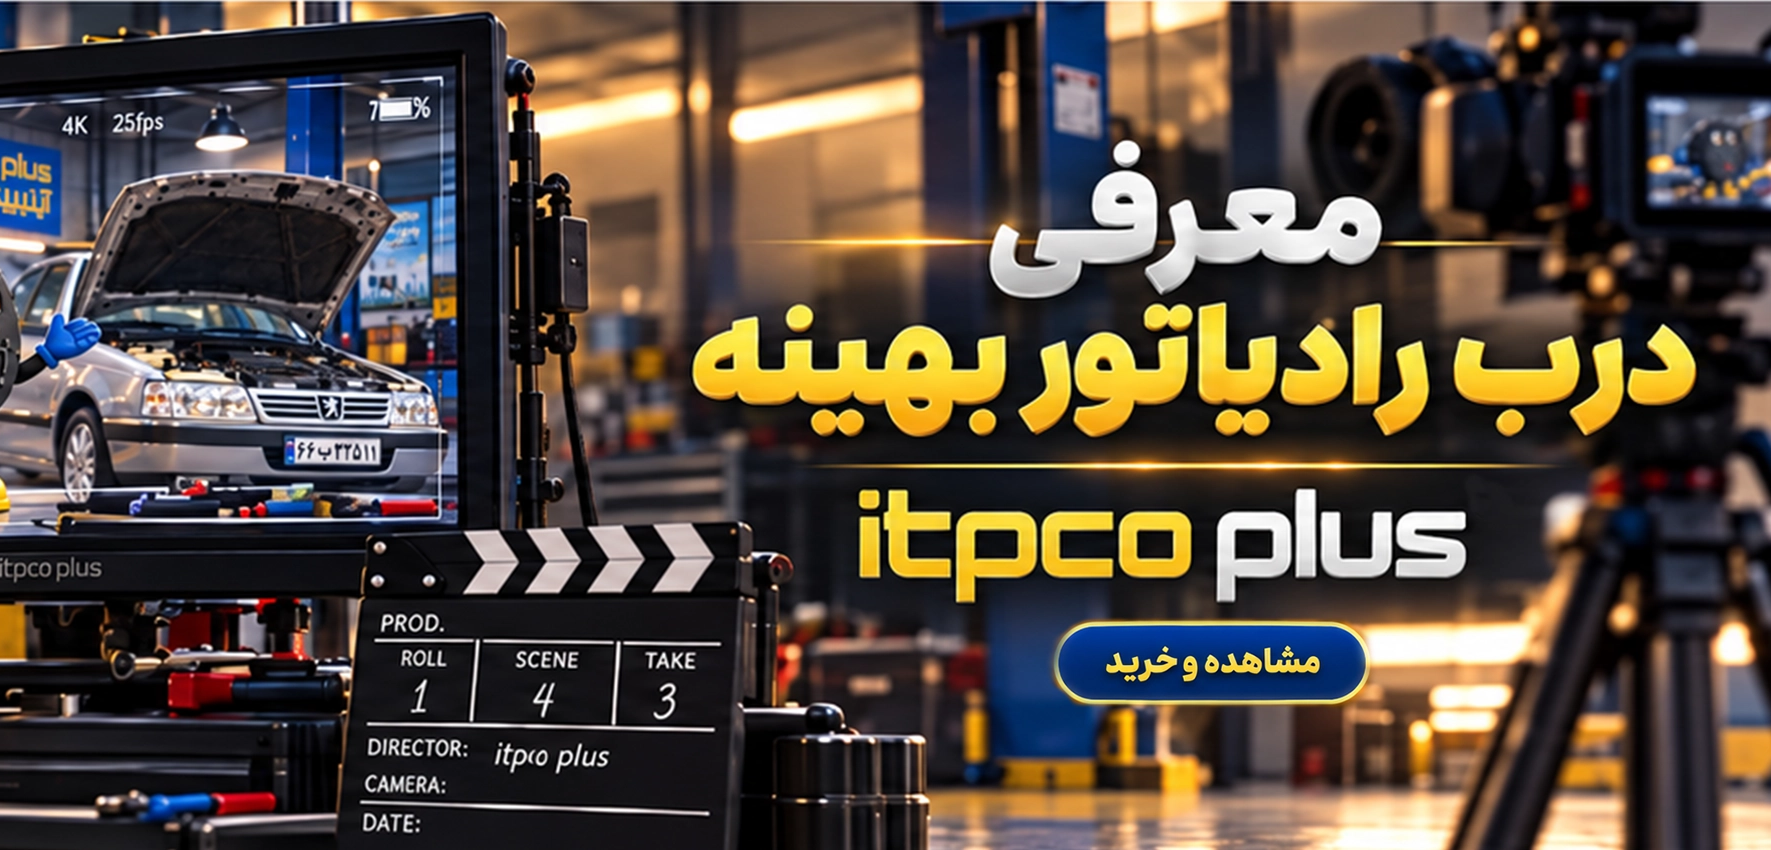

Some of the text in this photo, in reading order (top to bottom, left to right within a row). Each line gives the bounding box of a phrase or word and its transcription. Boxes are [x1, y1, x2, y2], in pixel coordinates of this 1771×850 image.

[61, 111, 165, 138] 4K 25fps
[1, 152, 52, 184] plus
[56, 556, 103, 582] plus
[380, 613, 445, 633] PROD.
[400, 649, 447, 668] ROLL
[515, 650, 579, 669] SCENE
[644, 651, 697, 670] TAKE
[410, 678, 428, 714] 1
[532, 682, 556, 718] 4
[652, 682, 677, 721] 3
[367, 737, 469, 758] DIRECTOR:
[555, 742, 610, 775] plus
[364, 774, 446, 794] CAMERA:
[362, 812, 421, 834] DATE:
